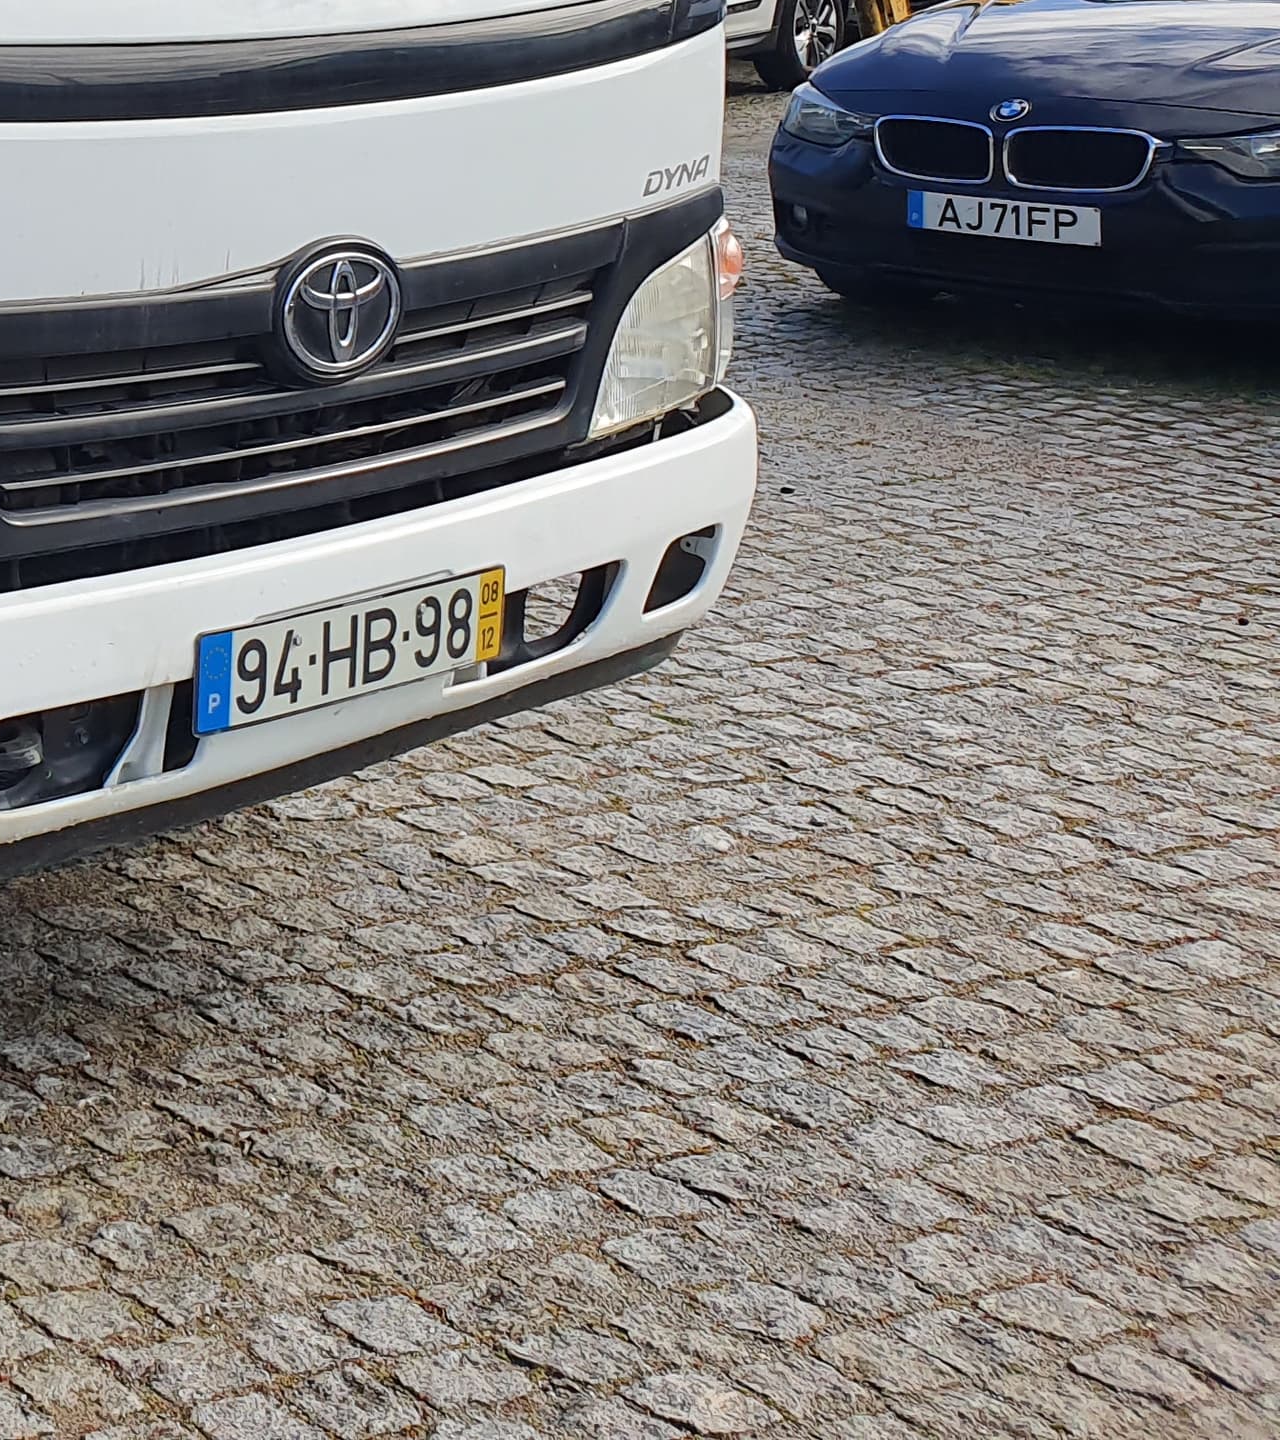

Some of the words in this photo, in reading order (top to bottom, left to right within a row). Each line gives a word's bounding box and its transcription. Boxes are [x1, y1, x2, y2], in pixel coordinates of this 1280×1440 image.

[642, 153, 710, 197] DYNA
[481, 579, 499, 606] 08
[480, 626, 495, 651] 12
[207, 692, 221, 714] P
